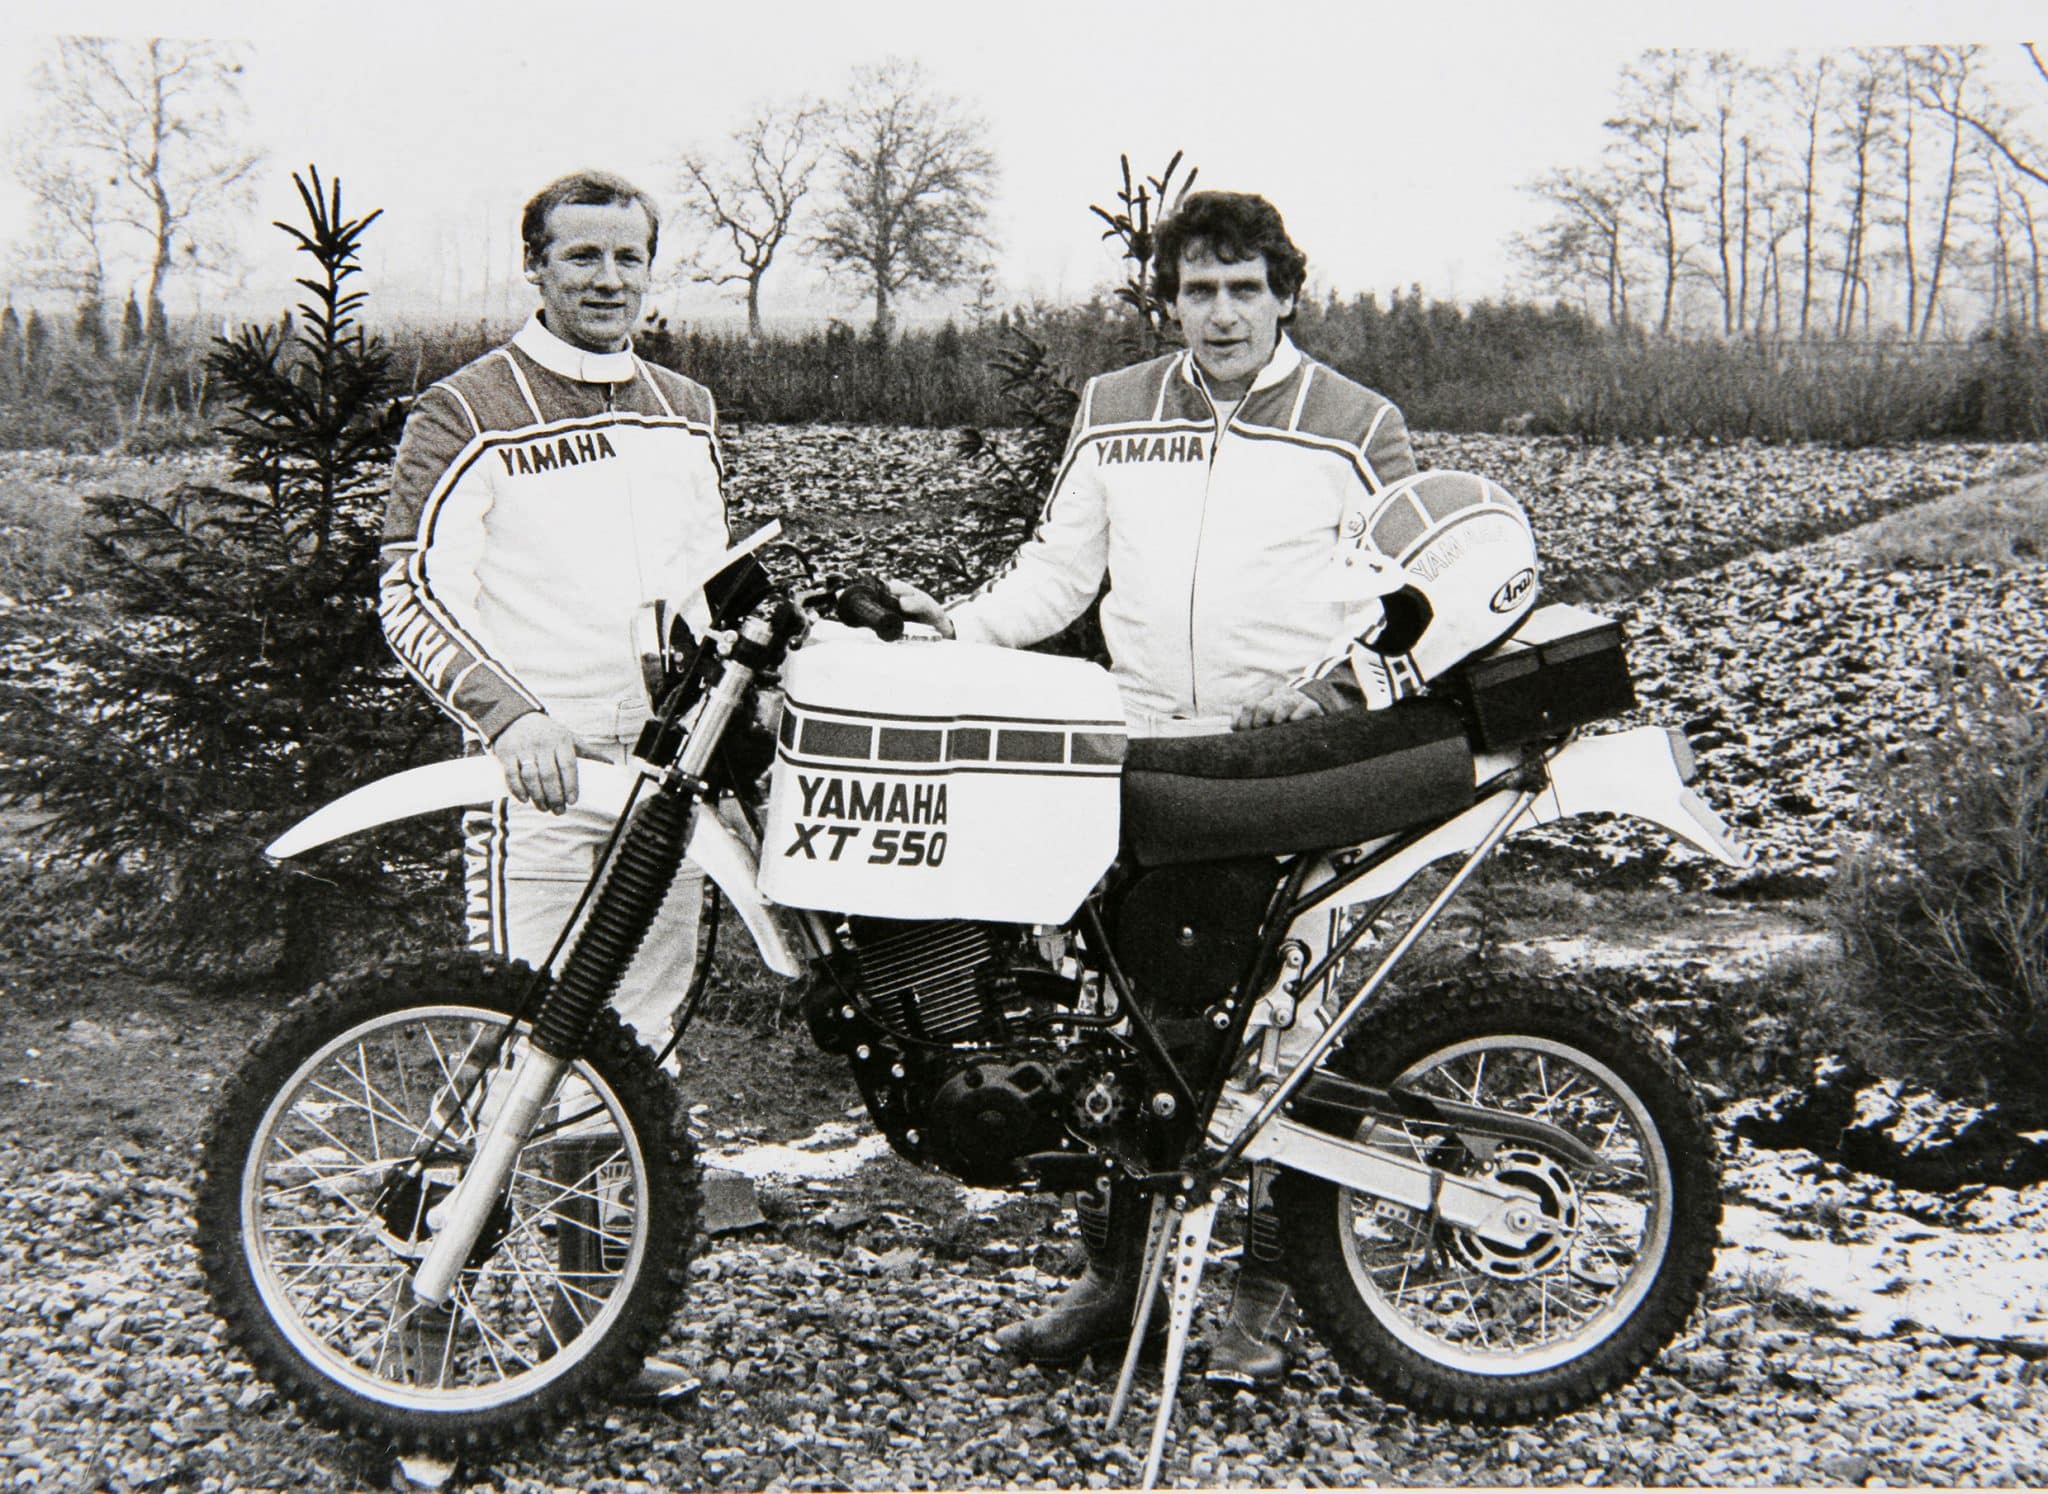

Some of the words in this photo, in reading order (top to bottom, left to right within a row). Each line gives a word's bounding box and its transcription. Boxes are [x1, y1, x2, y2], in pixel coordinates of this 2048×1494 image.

[498, 432, 616, 476] YAMAHA
[1096, 436, 1203, 466] YAMAHA
[1409, 524, 1508, 582] YAM
[1498, 573, 1531, 606] Arai
[798, 775, 947, 824] YAMAHA
[784, 823, 861, 861] XT
[867, 829, 947, 867] 550
